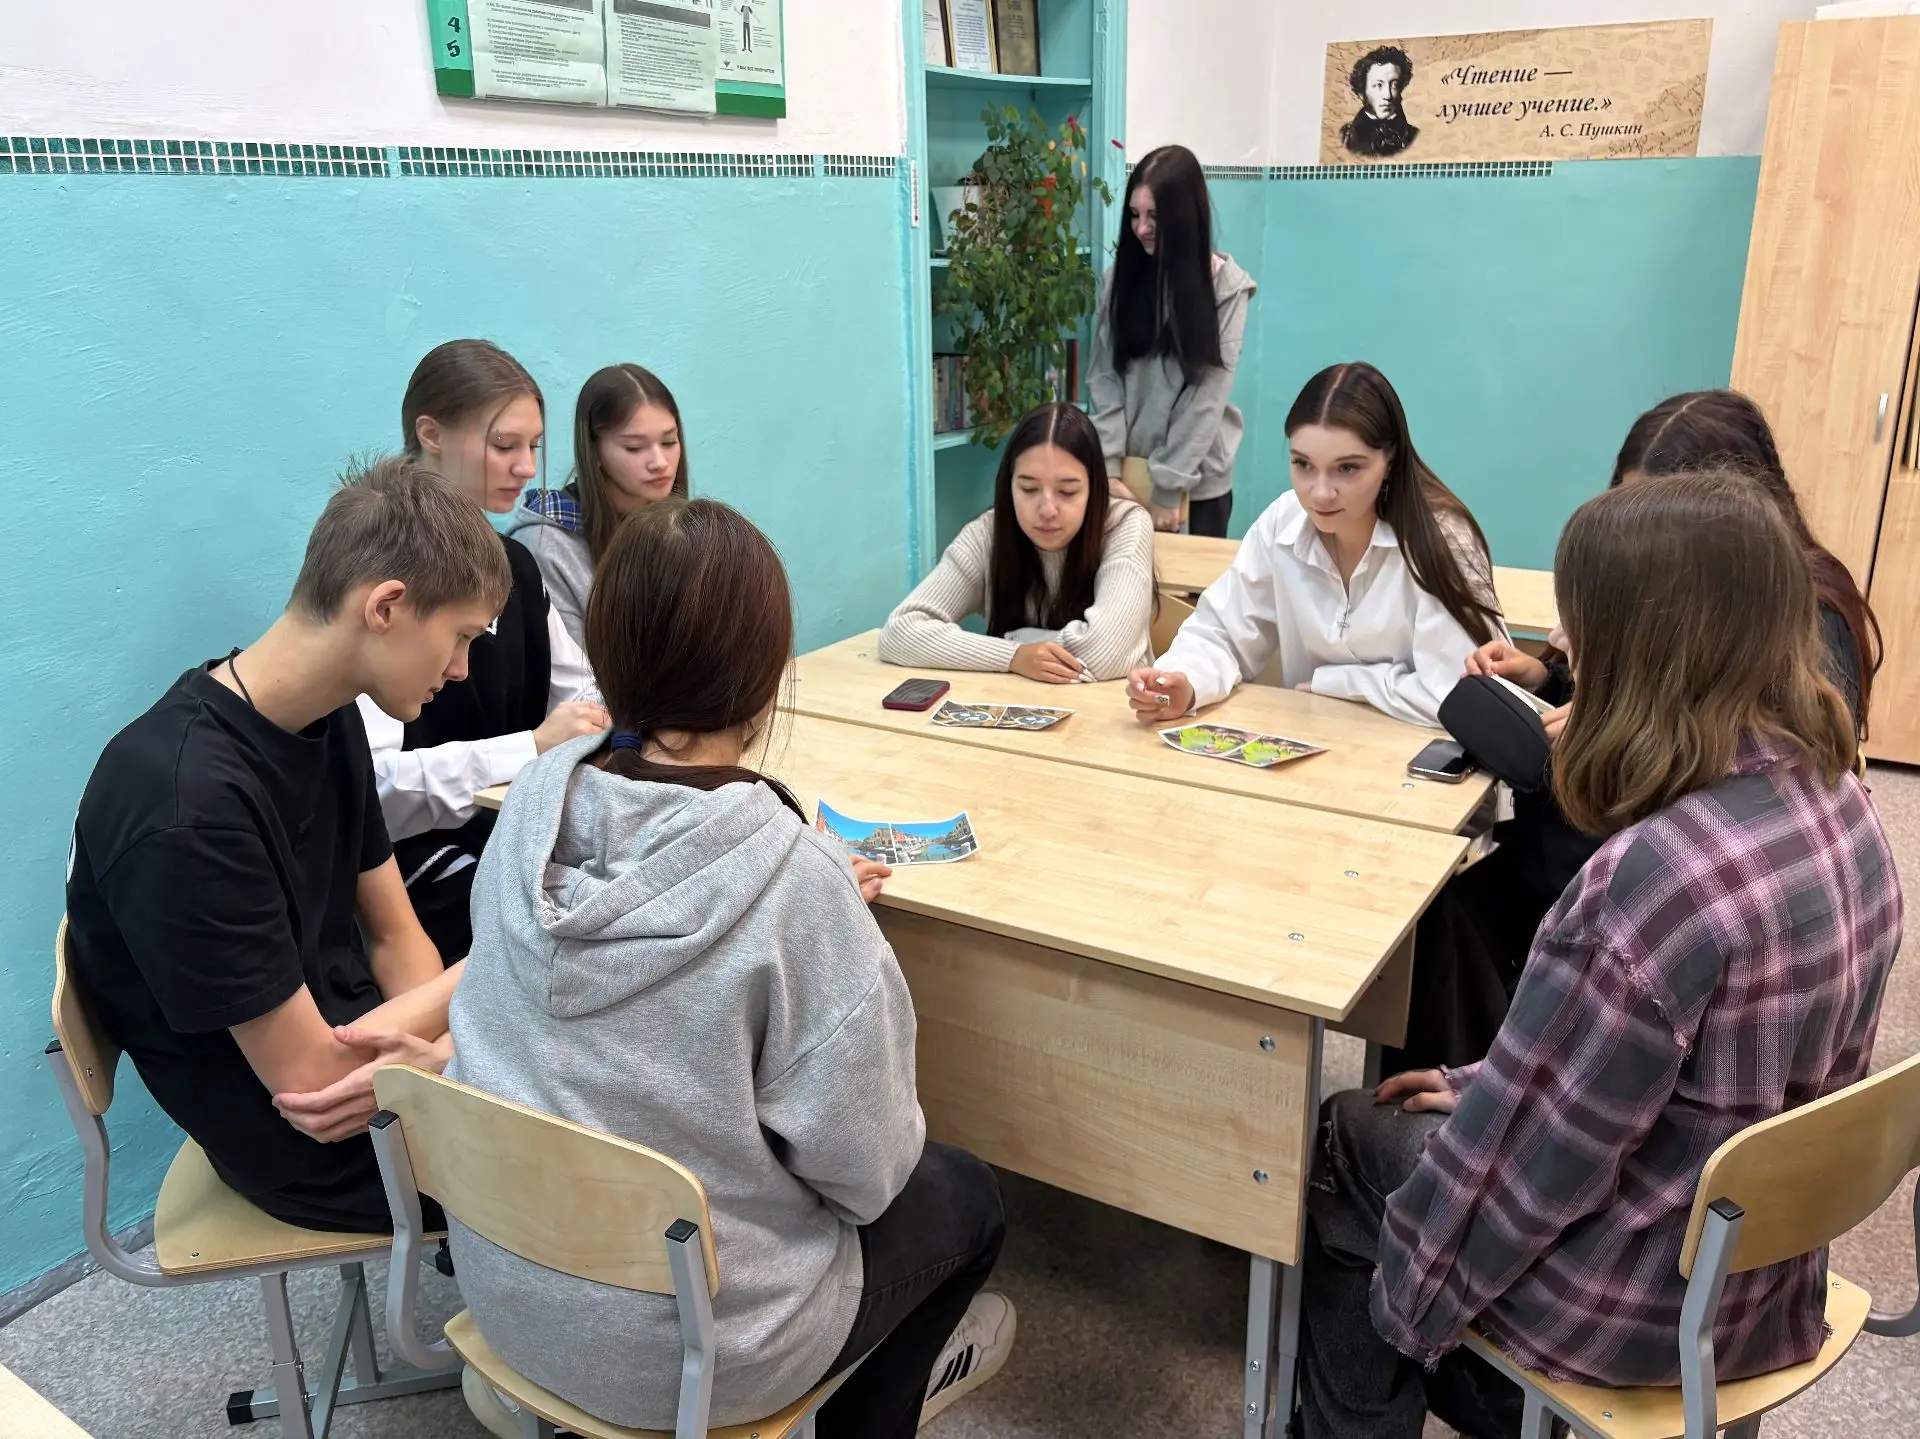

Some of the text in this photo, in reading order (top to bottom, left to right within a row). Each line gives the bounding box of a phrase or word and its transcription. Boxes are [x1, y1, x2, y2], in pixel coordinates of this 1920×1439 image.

[447, 16, 461, 34] 4
[446, 39, 461, 58] 5
[1440, 64, 1539, 86] «Чтение
[1435, 97, 1613, 124] лучшее учение.»
[1539, 124, 1555, 138] А.
[1560, 123, 1574, 137] С.
[1579, 122, 1644, 141] Пушкин
